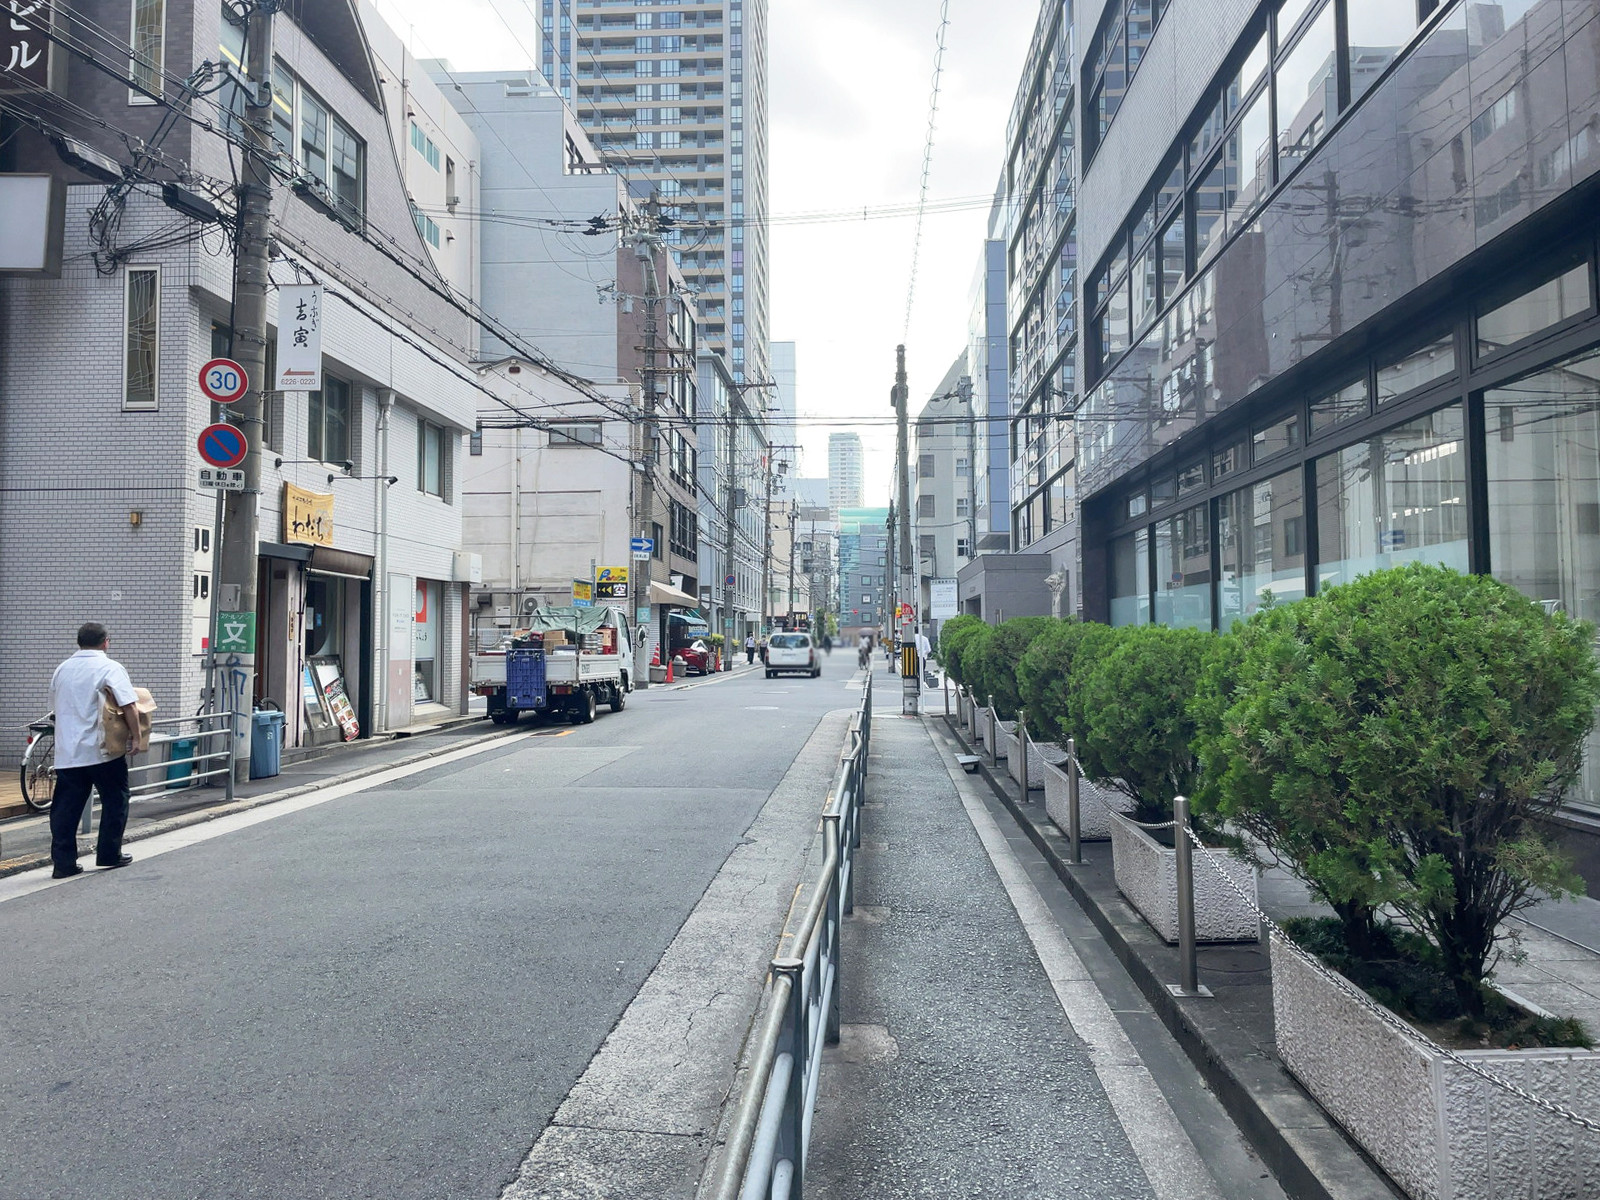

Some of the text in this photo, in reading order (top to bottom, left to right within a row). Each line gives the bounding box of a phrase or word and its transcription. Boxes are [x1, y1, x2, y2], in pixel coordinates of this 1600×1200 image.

[210, 371, 237, 391] 30
[200, 470, 242, 481] 自動車
[292, 505, 324, 541] わだち
[613, 584, 626, 597] 空
[222, 621, 247, 644] 文
